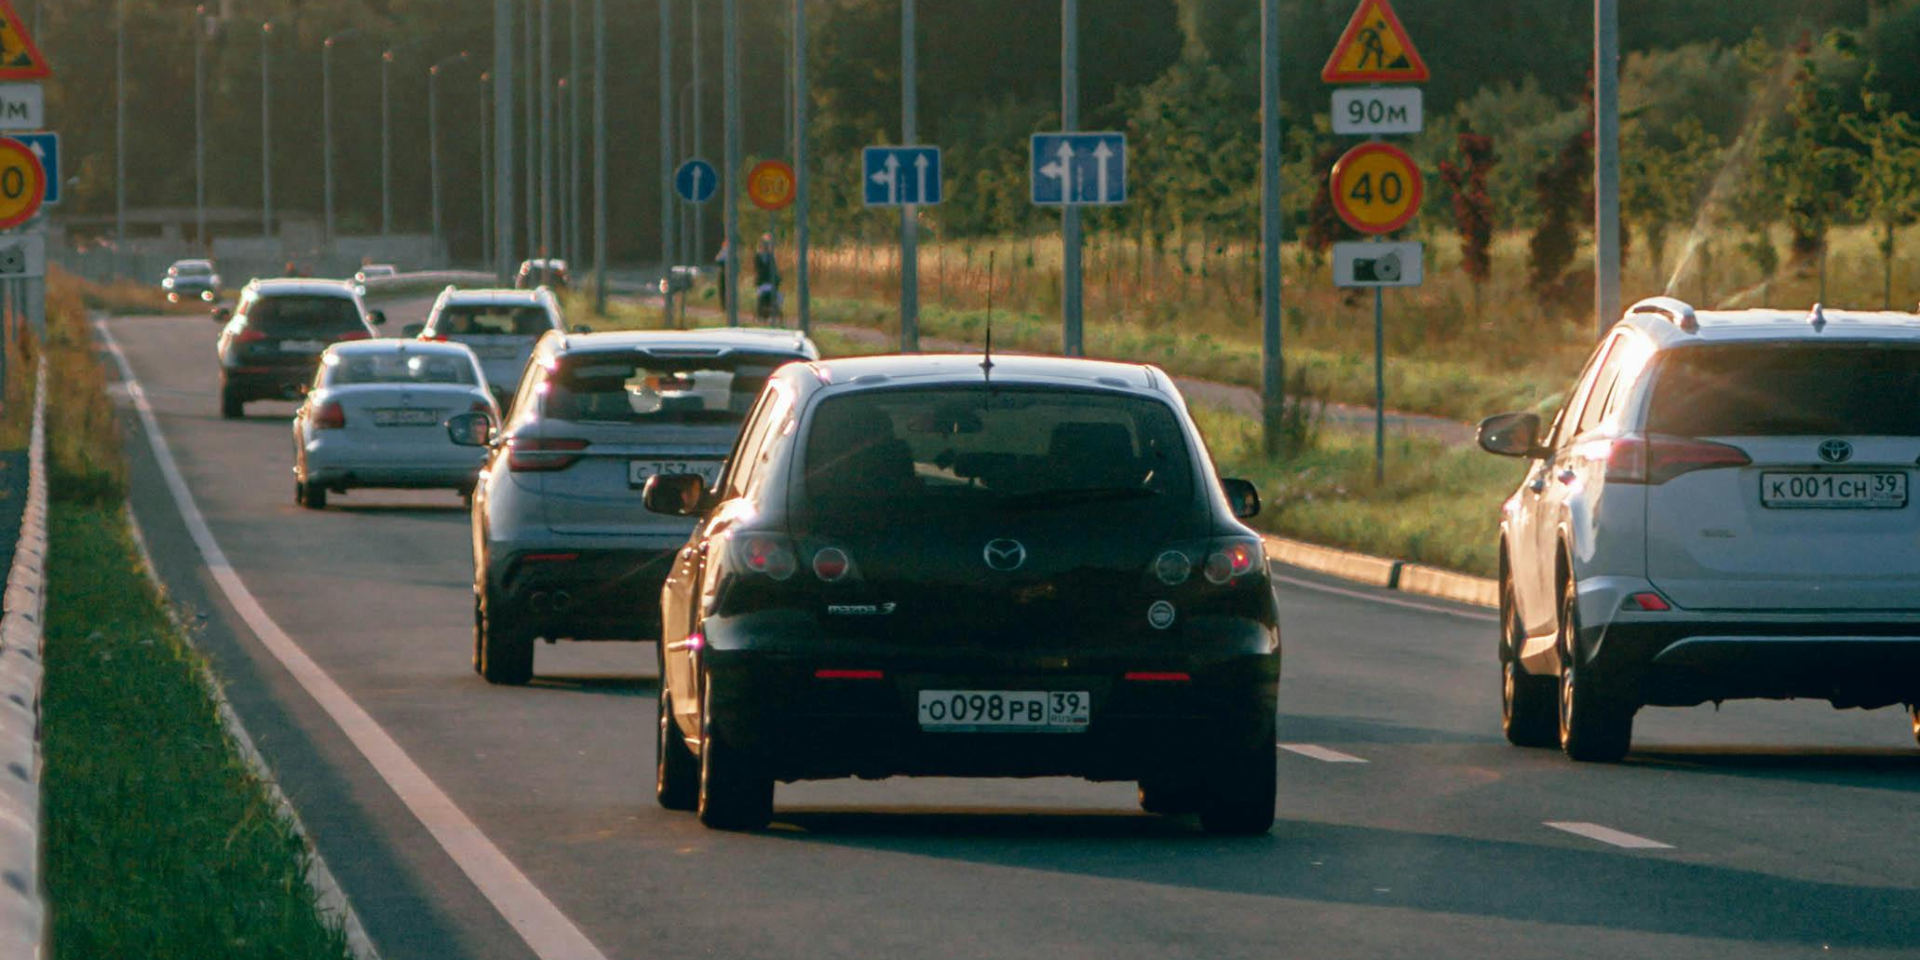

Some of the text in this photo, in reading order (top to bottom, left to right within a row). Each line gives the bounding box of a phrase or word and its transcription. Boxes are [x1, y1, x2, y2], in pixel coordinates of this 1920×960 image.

[1350, 172, 1403, 205] 40
[1875, 475, 1897, 492] 39
[880, 602, 897, 615] 3
[1052, 693, 1080, 714] 39
[1051, 715, 1073, 723] RUS
